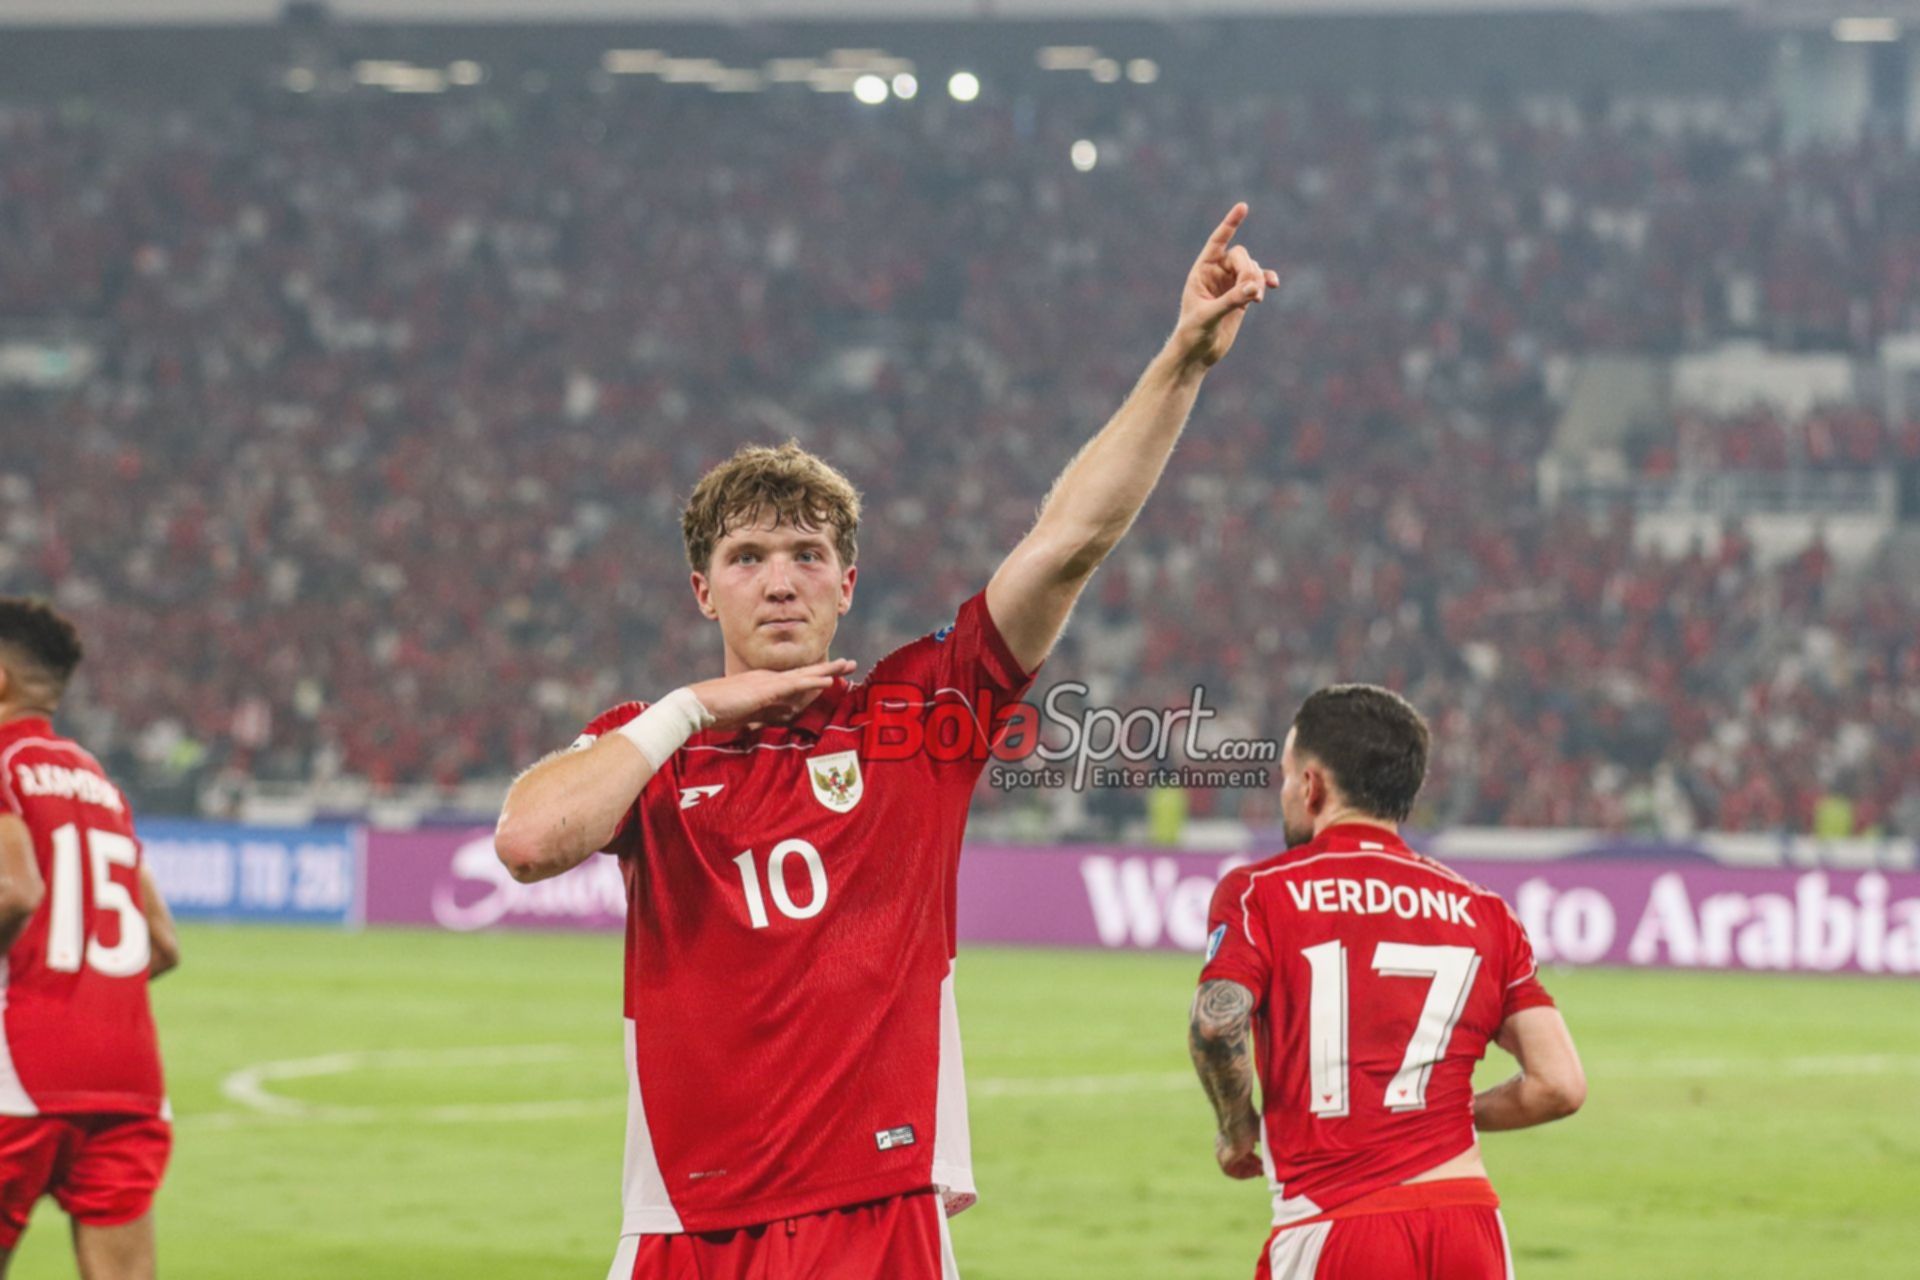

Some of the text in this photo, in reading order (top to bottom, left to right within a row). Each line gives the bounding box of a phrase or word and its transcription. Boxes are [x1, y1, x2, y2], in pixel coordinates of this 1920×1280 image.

[47, 822, 151, 977] 15
[732, 838, 828, 929] 10
[1286, 878, 1476, 928] VERDONK
[1515, 876, 1616, 963] to
[1301, 939, 1482, 1118] 17
